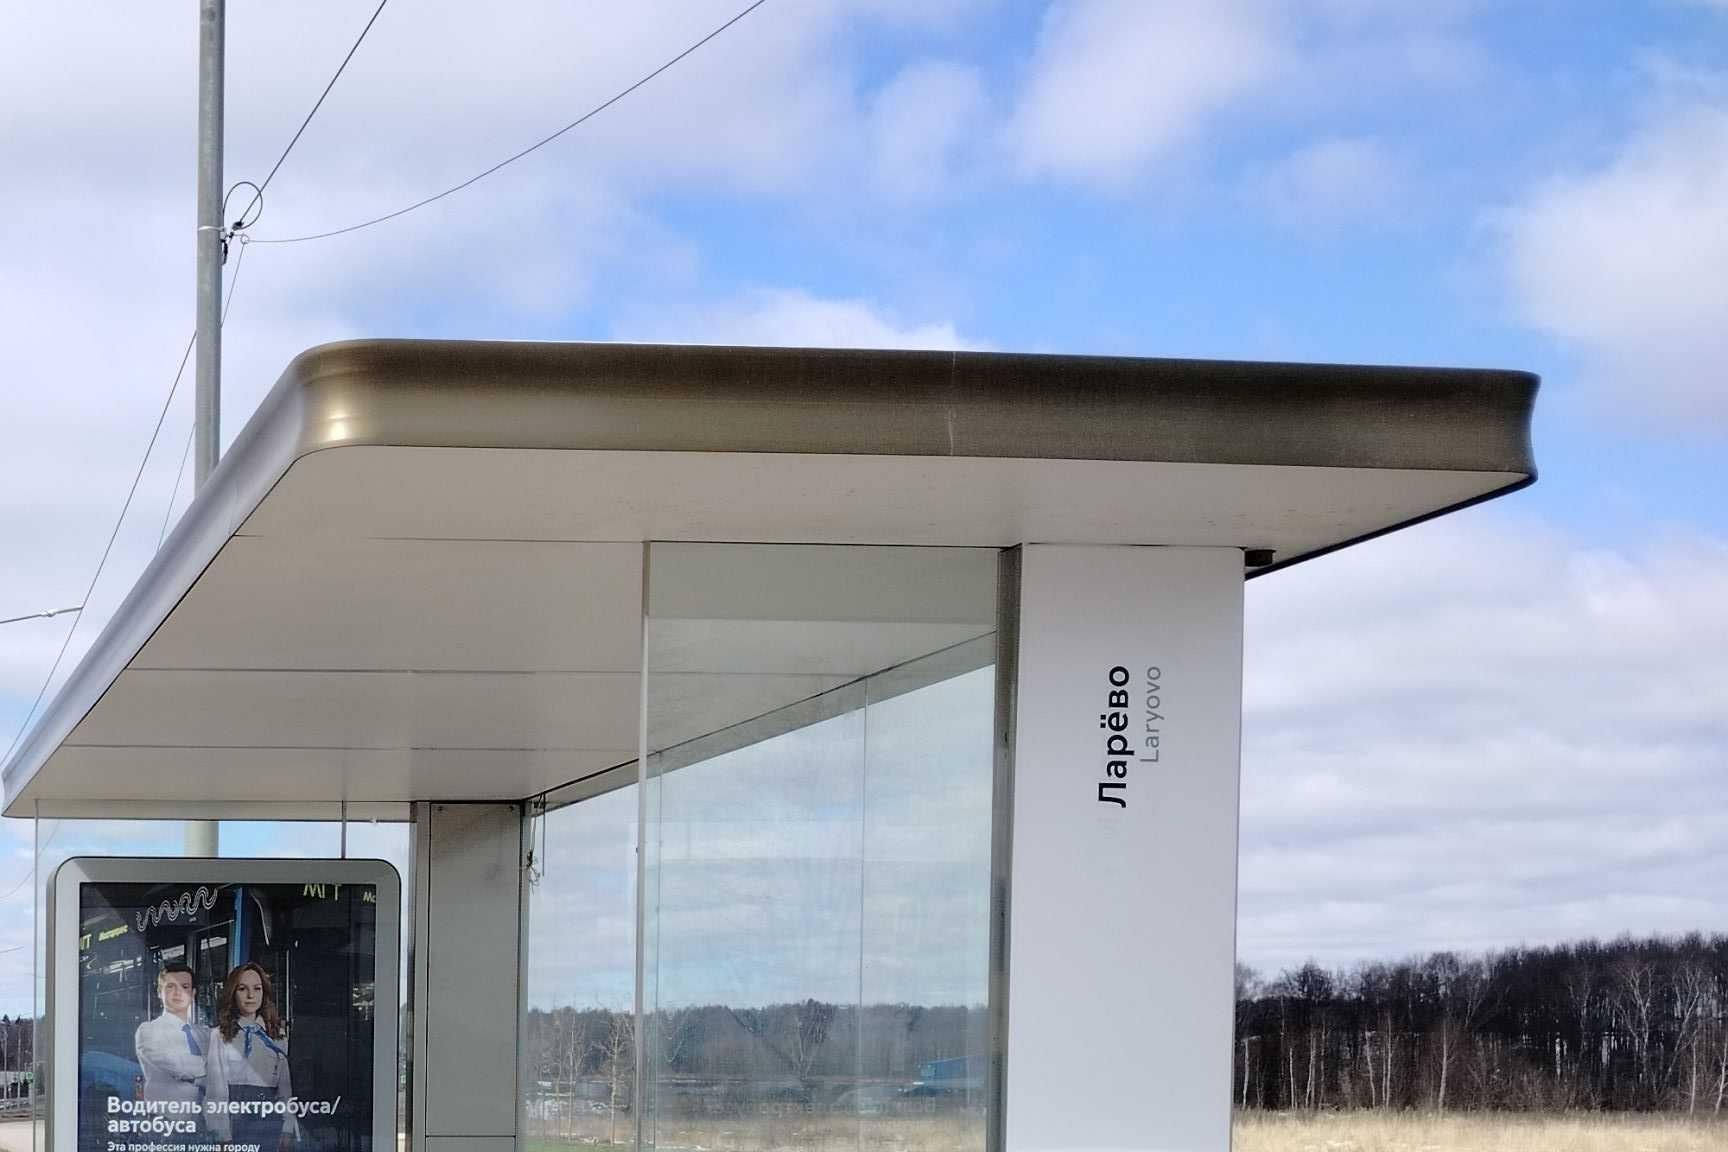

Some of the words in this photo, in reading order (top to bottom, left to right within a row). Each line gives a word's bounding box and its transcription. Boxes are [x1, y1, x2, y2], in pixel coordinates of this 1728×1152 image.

[1140, 666, 1165, 763] Laryovo
[1098, 666, 1135, 808] Ларёво
[107, 1097, 202, 1116] Водитель
[206, 1096, 341, 1118] электробуса/
[107, 1116, 196, 1136] автобуса
[107, 1142, 126, 1152] Эта
